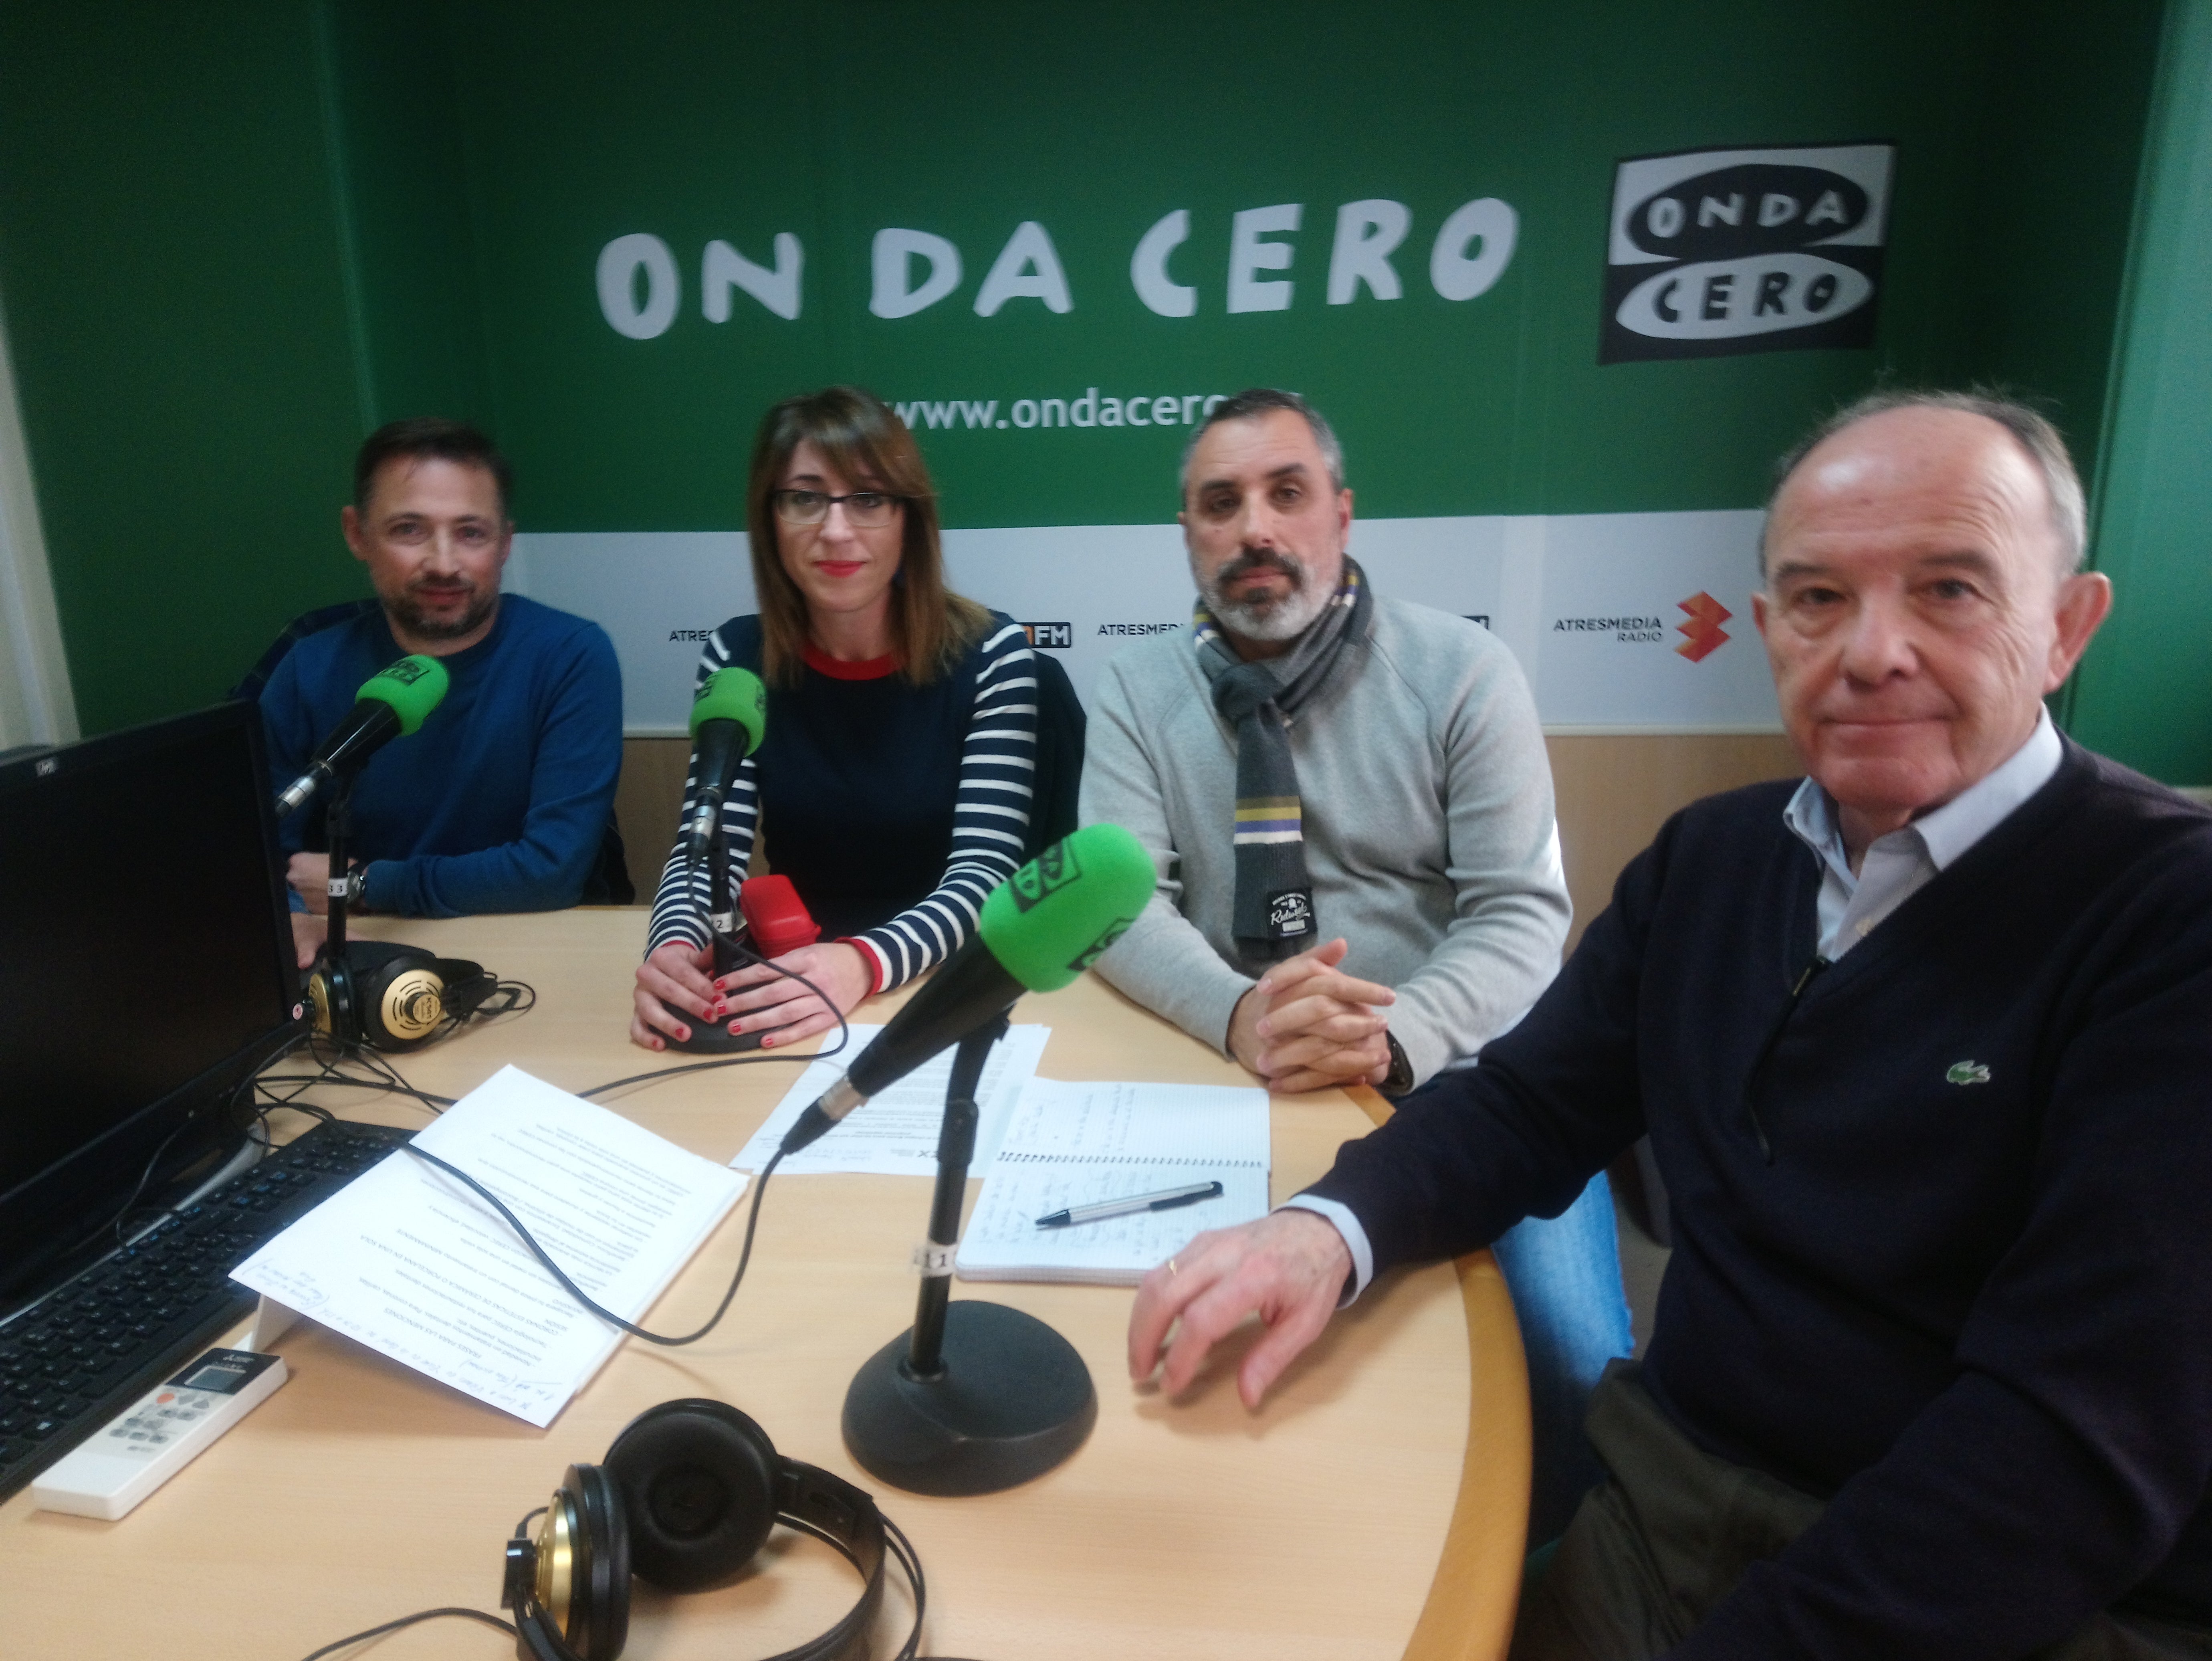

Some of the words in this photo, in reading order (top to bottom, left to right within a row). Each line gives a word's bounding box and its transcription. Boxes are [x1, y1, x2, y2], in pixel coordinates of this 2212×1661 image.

[1647, 190, 1847, 238] ONDA
[1130, 197, 1519, 317] CERO
[1653, 272, 1837, 323] CERO
[1553, 616, 1662, 631] ATRESMEDIA
[1617, 631, 1662, 642] RADIO
